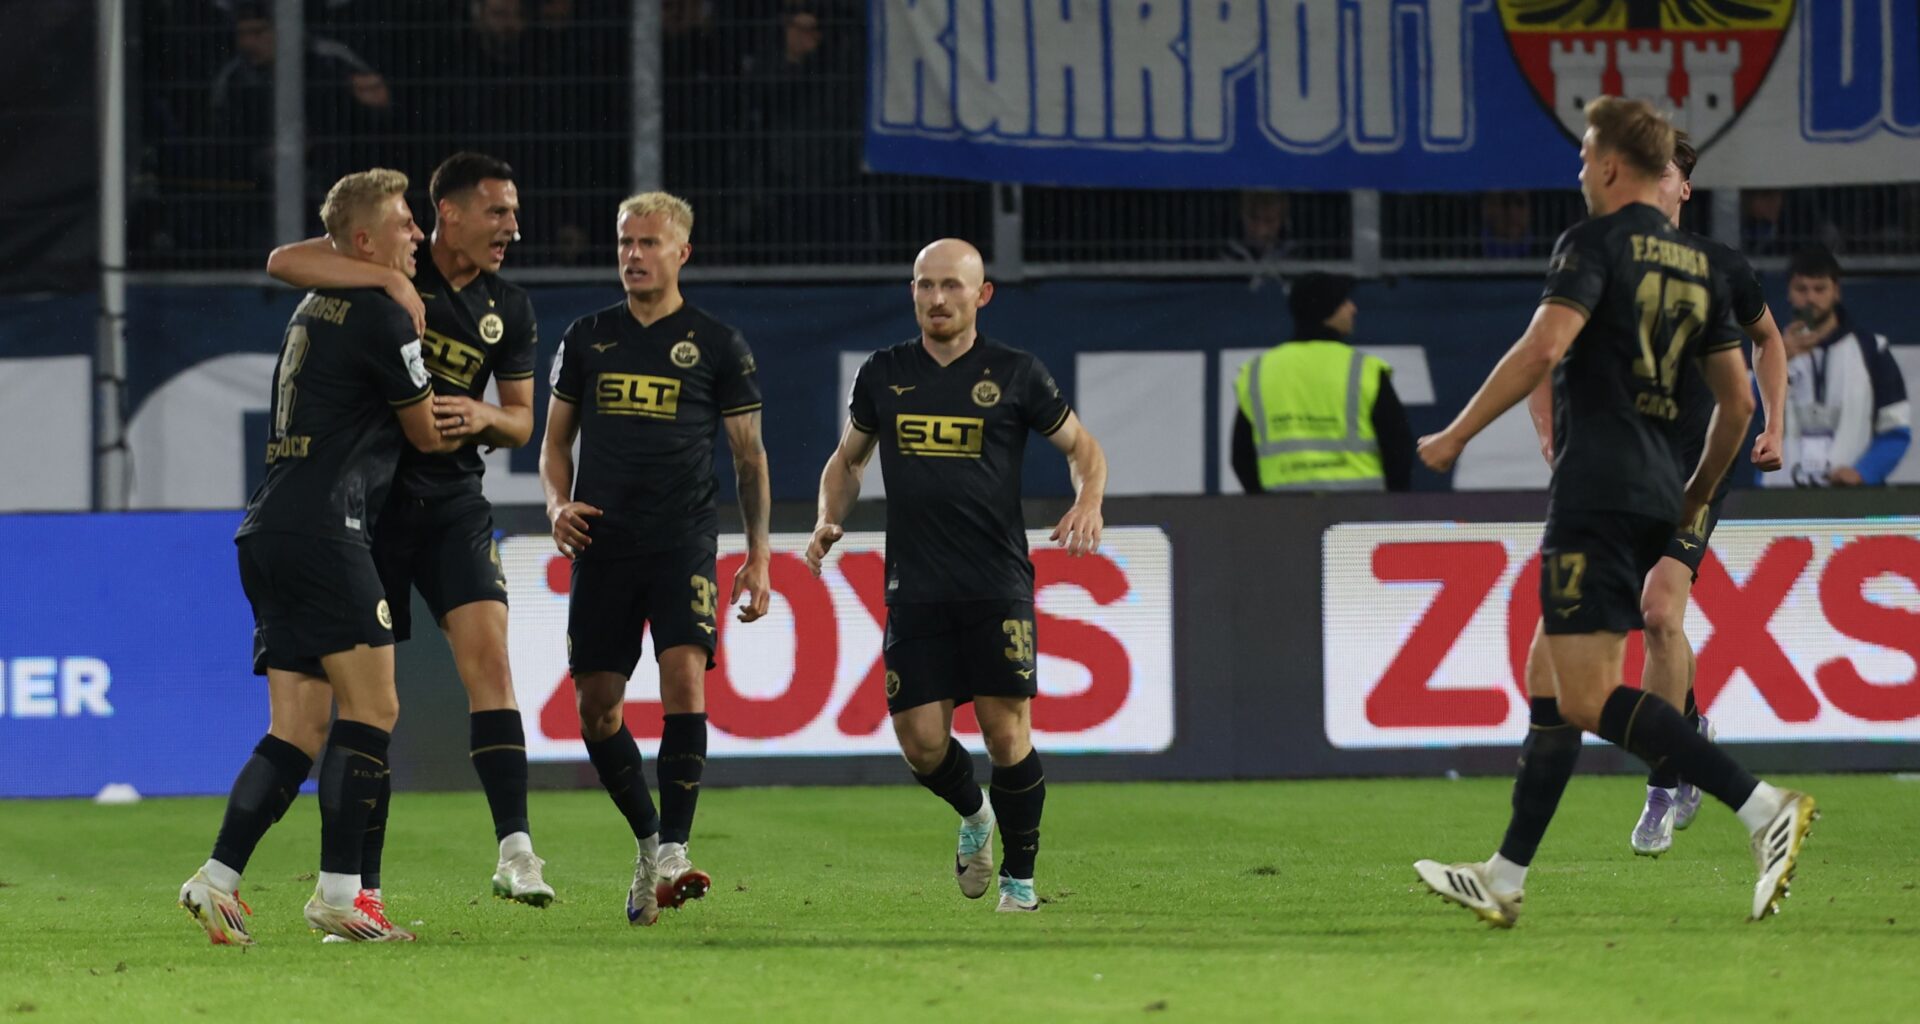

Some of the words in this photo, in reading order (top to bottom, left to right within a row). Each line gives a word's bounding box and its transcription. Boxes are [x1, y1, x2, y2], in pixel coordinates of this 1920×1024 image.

[1634, 271, 1710, 394] 17
[421, 335, 480, 376] SLT
[599, 379, 676, 406] SLT
[900, 420, 979, 446] SLT
[1548, 552, 1586, 599] 17
[0, 656, 115, 718] ER
